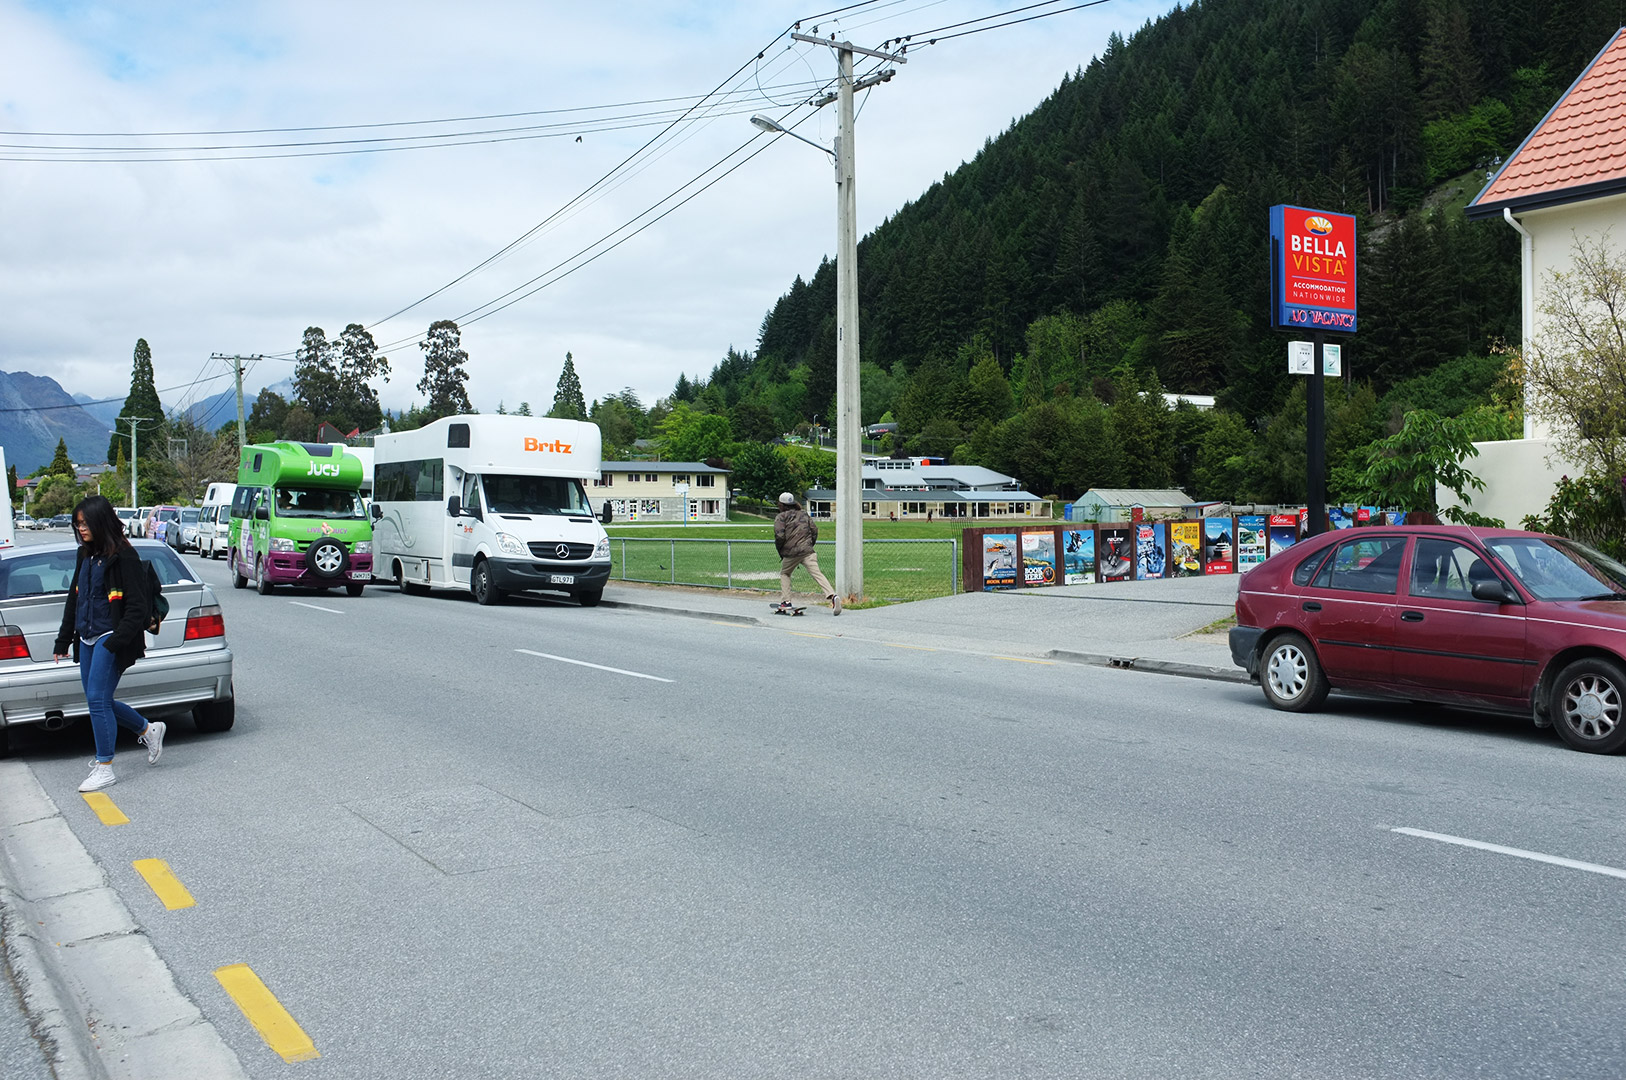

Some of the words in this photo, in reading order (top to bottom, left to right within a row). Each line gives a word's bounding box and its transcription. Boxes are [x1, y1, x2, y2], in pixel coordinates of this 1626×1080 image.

[1291, 234, 1347, 258] BELLA
[1292, 253, 1346, 276] VISTA
[1293, 281, 1346, 293] ACCOMMODATION
[1292, 291, 1346, 303] NATIONWIDE
[1291, 309, 1307, 323] NO
[1309, 310, 1355, 328] VACANCY
[524, 437, 572, 454] Britz
[1025, 567, 1043, 575] BOOK
